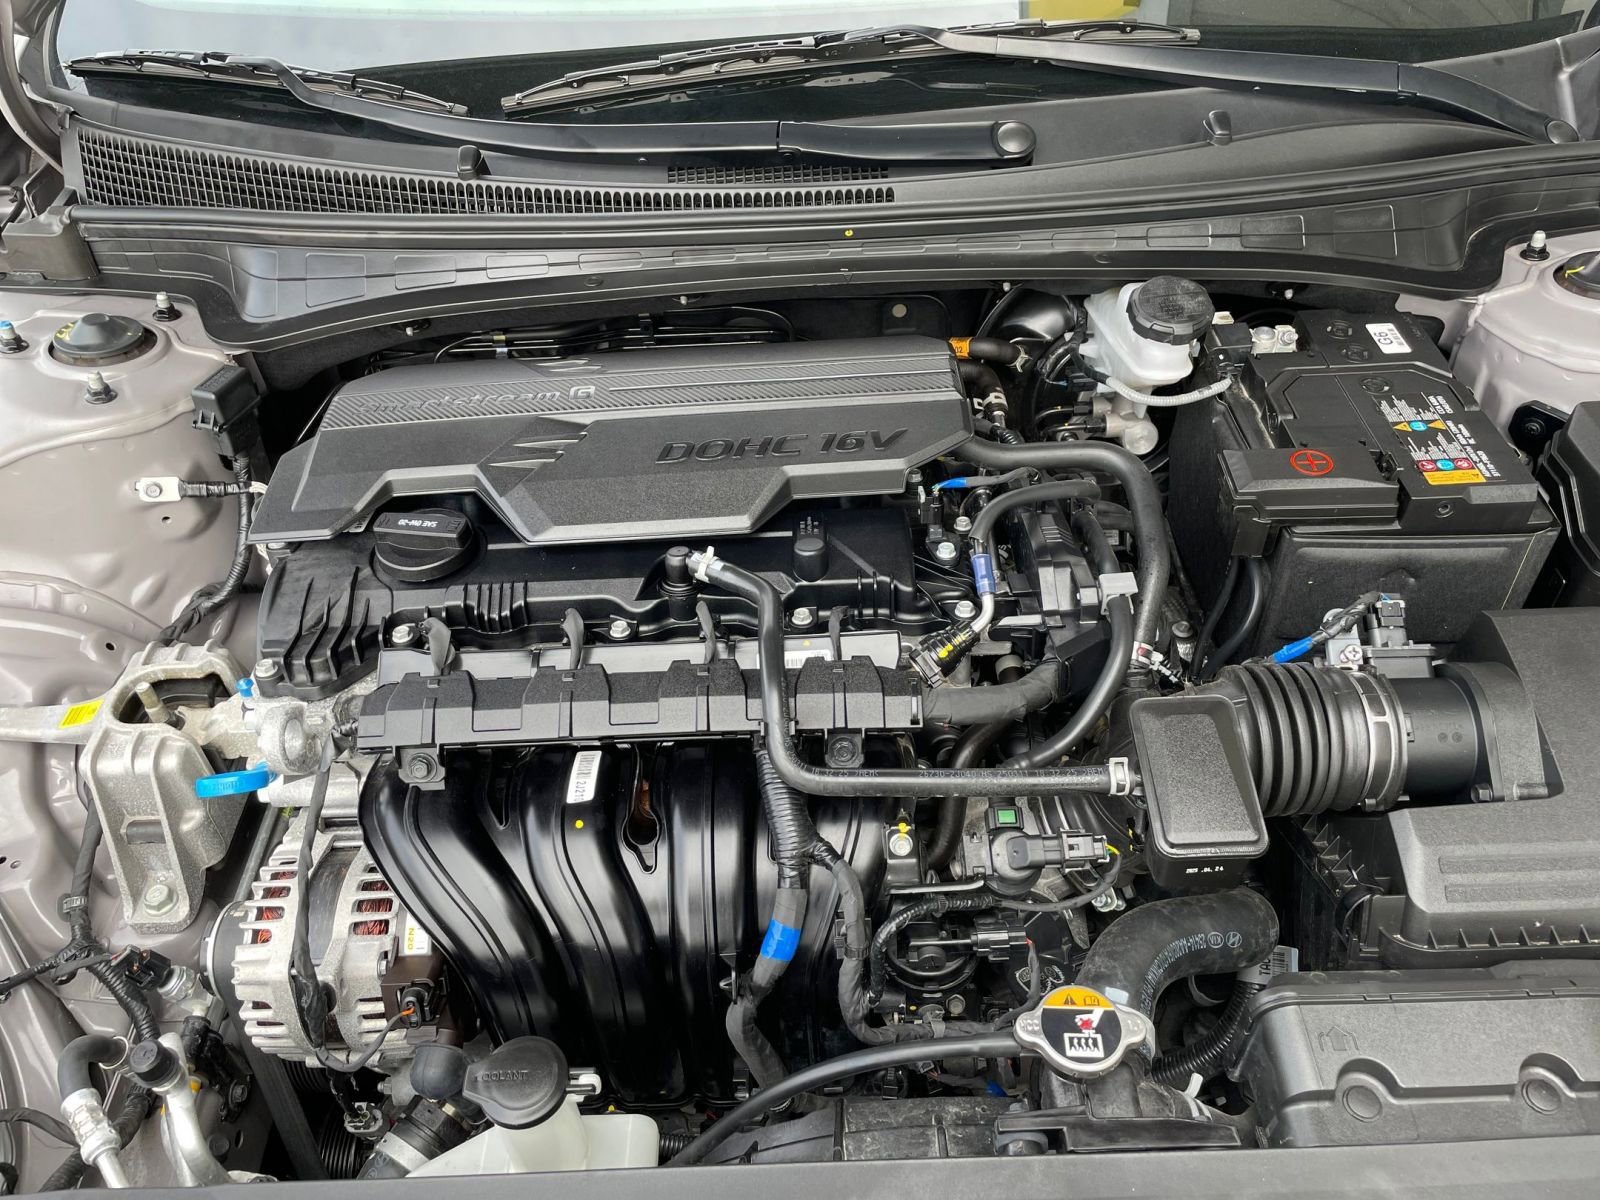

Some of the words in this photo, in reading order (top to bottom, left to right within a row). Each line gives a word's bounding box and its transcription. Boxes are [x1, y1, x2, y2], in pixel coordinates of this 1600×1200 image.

[568, 385, 596, 400] G
[655, 433, 808, 465] DOHC
[819, 428, 908, 454] 16V
[397, 519, 422, 527] 0W-20
[422, 520, 438, 528] SAE
